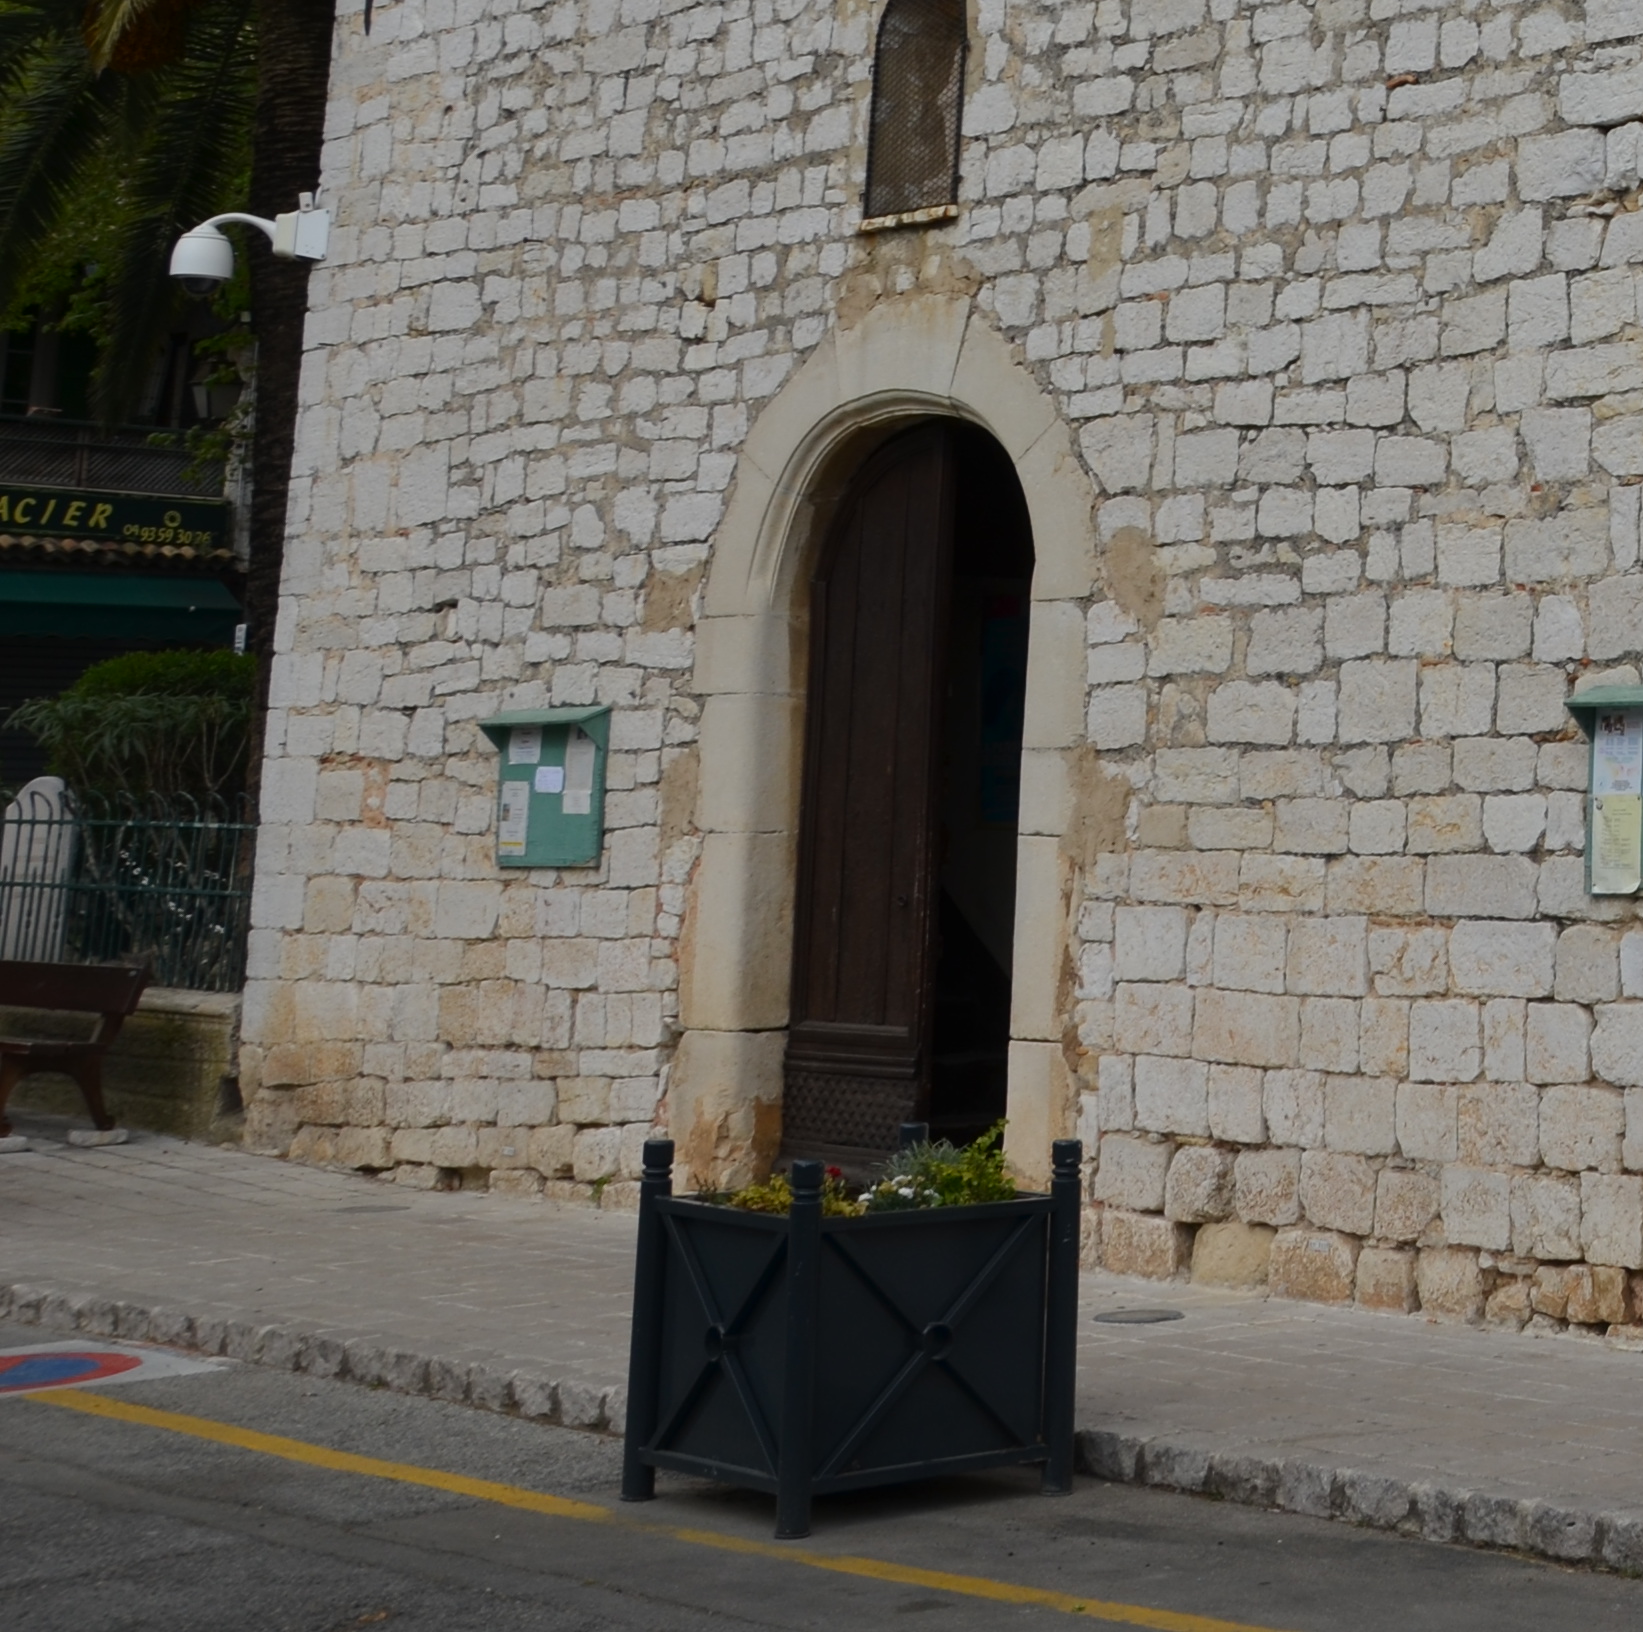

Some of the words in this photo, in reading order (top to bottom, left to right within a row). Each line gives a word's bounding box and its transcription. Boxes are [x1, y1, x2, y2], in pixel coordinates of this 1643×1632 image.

[140, 527, 156, 542] 93
[156, 528, 173, 543] 59
[176, 529, 193, 544] 30
